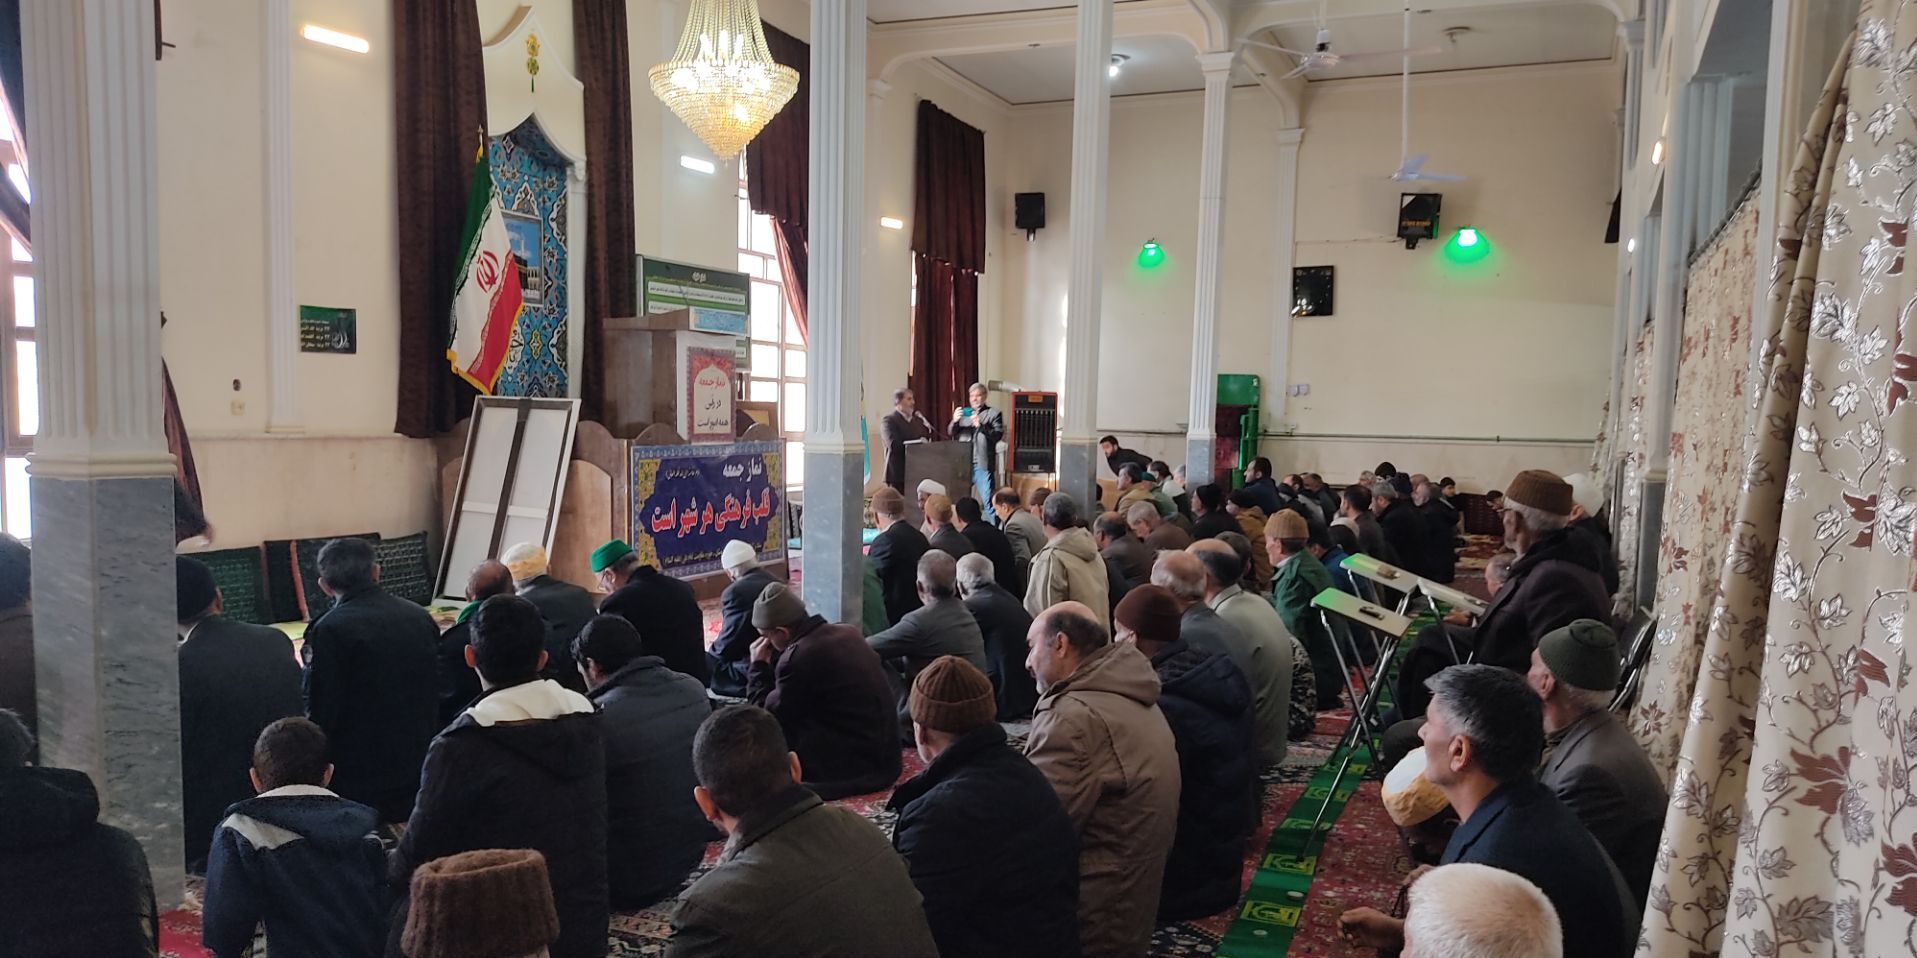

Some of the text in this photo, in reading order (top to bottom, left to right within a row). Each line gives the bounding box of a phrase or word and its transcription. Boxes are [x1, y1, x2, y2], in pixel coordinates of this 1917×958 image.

[722, 461, 745, 482] جمعه
[746, 456, 763, 482] نماز
[651, 486, 771, 538] قلب فرهنگی هر شهر است
